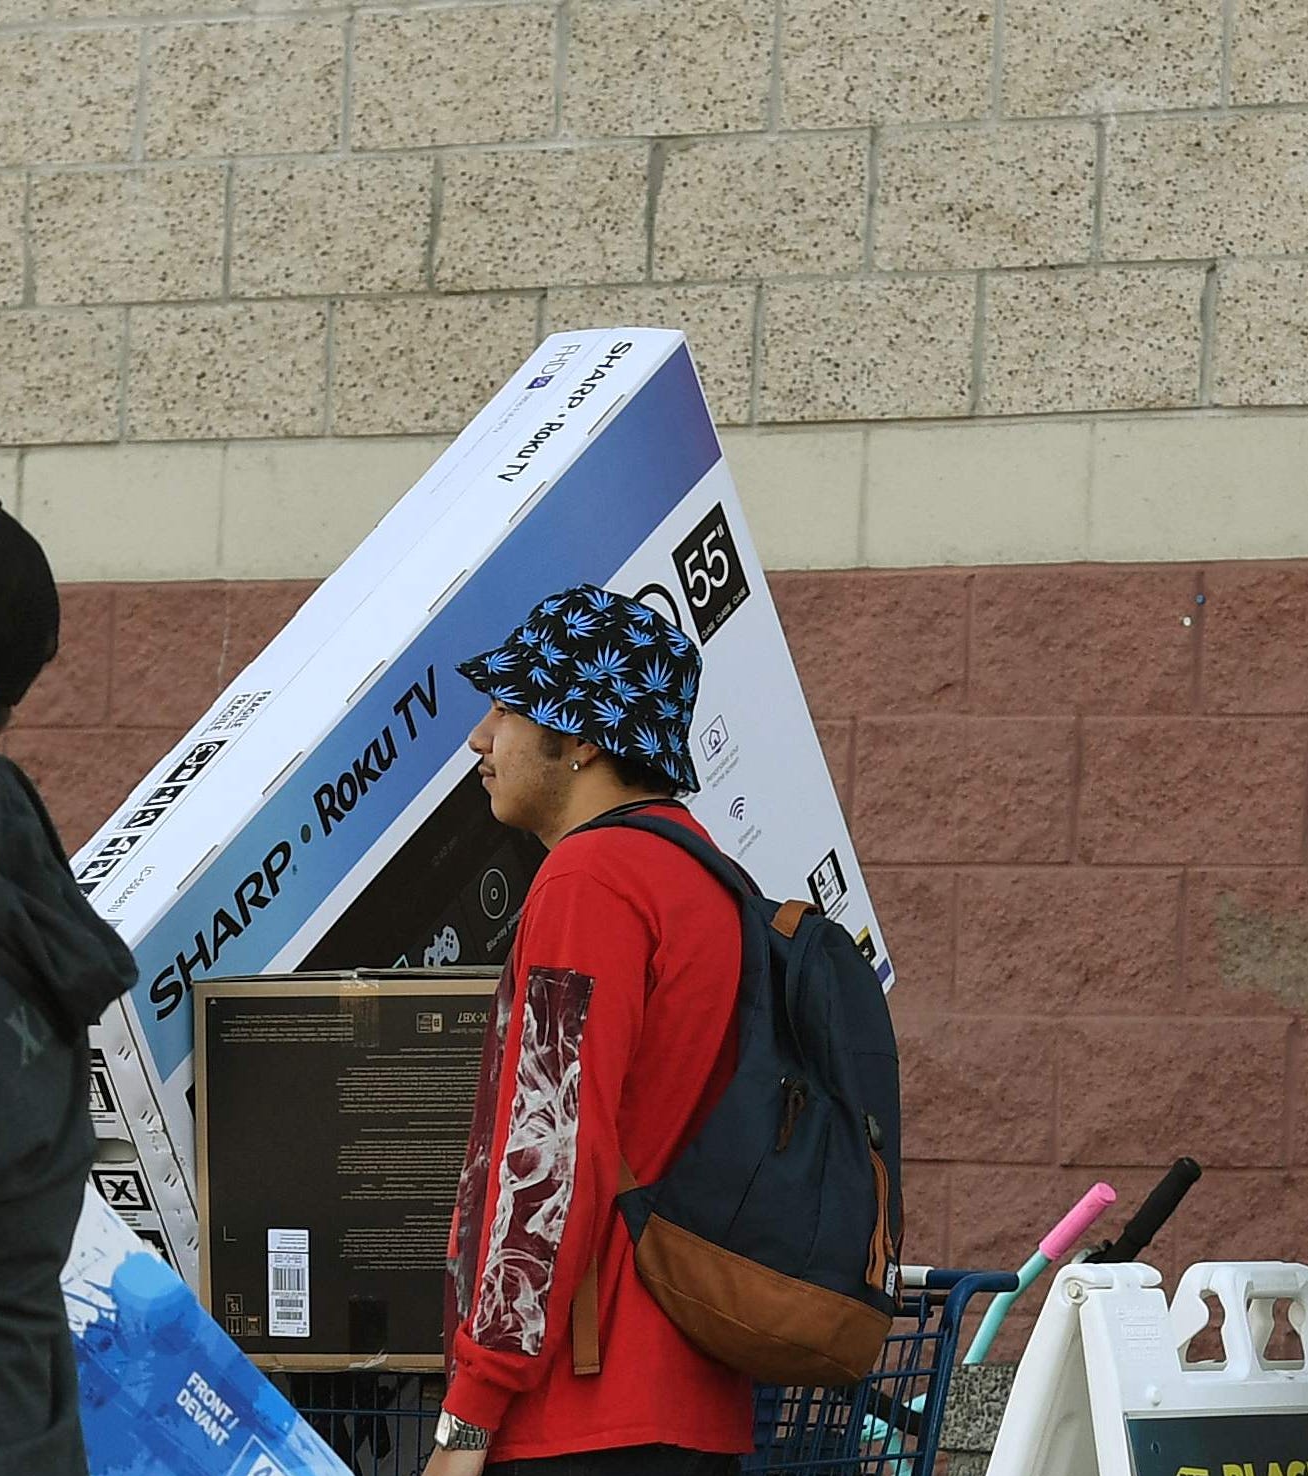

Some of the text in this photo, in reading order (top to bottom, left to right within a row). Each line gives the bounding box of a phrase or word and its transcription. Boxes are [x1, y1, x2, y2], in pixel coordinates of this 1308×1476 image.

[541, 344, 581, 375] FHD
[567, 341, 634, 409] SHARP
[497, 462, 529, 482] TV
[684, 523, 725, 608] 55"
[210, 693, 251, 732] FRAGILE
[233, 690, 272, 729] FRAGILE
[149, 840, 292, 1022] SHARP
[393, 664, 440, 741] TV
[817, 870, 826, 888] 4
[176, 1388, 230, 1446] DEVANT
[187, 1371, 234, 1425] FRONT
